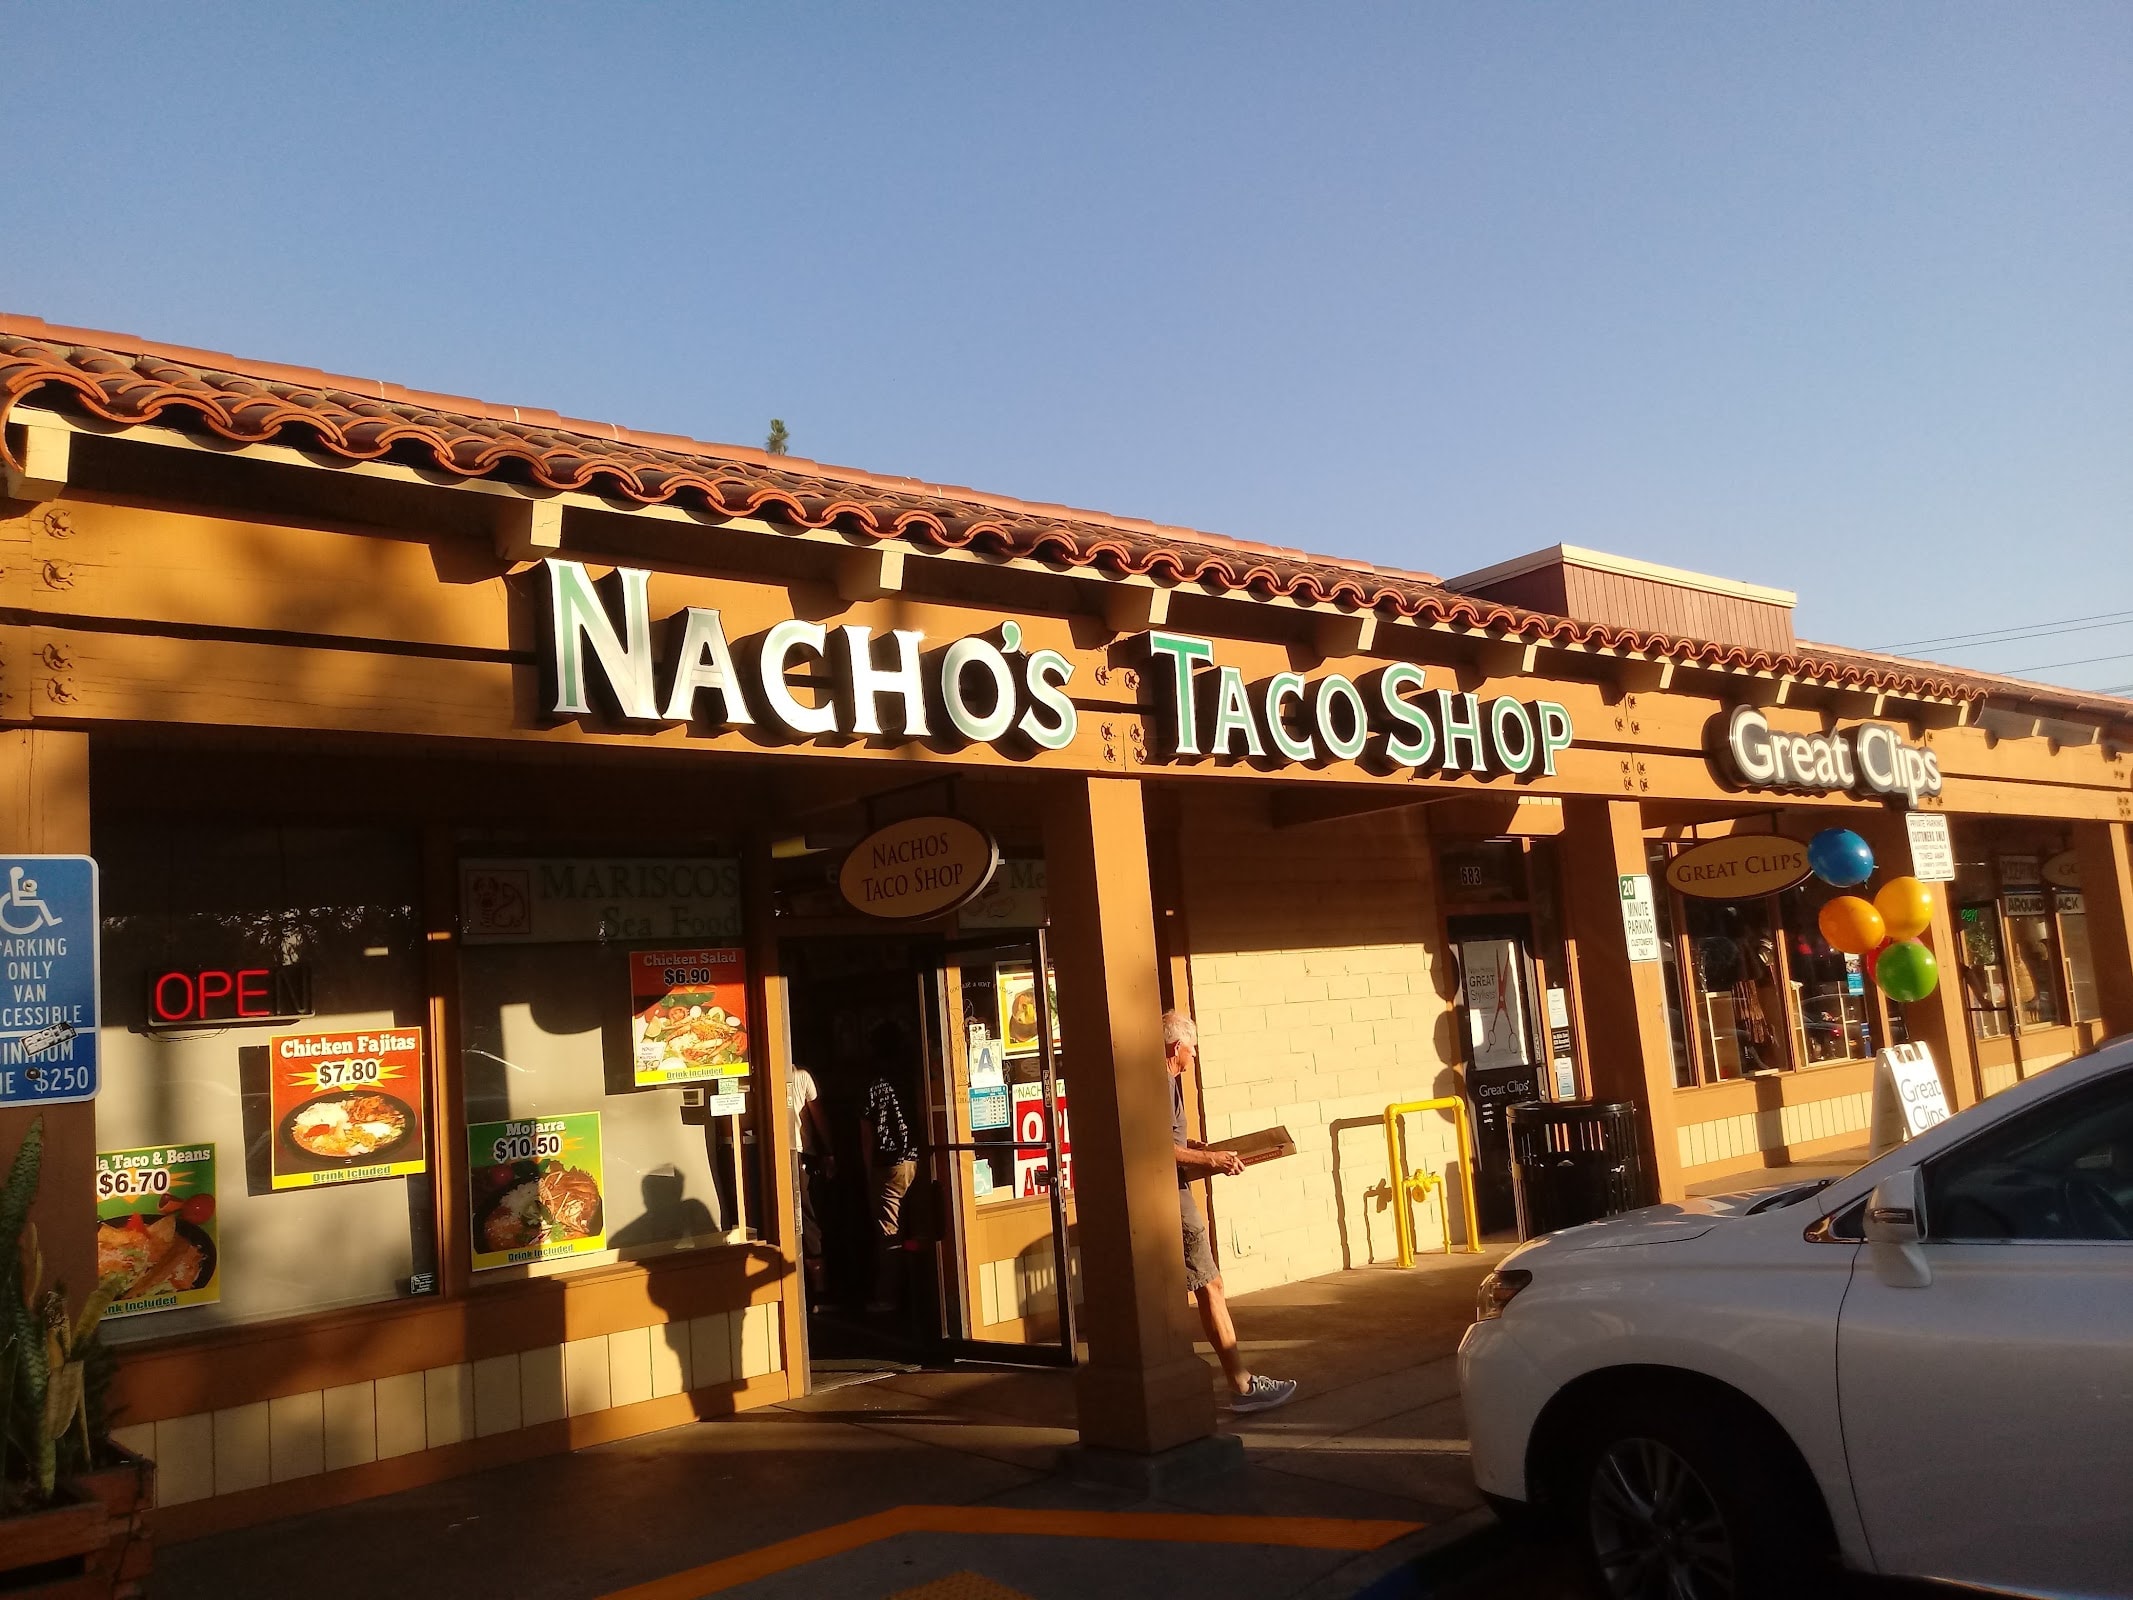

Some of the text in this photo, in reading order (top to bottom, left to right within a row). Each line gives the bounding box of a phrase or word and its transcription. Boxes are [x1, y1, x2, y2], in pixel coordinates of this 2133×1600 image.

[543, 557, 1078, 751] NACHO'S
[1149, 629, 1574, 776] TACO SHOP
[1733, 710, 1942, 810] Great Clips
[872, 832, 948, 869] NACHOS
[1460, 867, 1481, 885] 683
[1676, 853, 1803, 883] GREAT CLIPS
[539, 864, 738, 900] MARISCOS
[862, 874, 908, 902] TACO
[914, 863, 963, 893] SHOP
[1622, 880, 1634, 896] 20
[1627, 901, 1649, 917] MINUTE
[2056, 896, 2079, 911] ACK
[600, 904, 739, 938] Sea Food
[1628, 919, 1653, 935] PARKING
[1631, 937, 1654, 947] CUSTOMERS
[1638, 948, 1648, 956] ONLY
[643, 951, 737, 967] Chicken Salad
[8, 961, 53, 981] ONLY
[663, 968, 711, 986] $6.90
[1469, 974, 1495, 988] GREAT
[14, 984, 46, 1003] VAN
[154, 968, 311, 1020] OPEN
[2, 1005, 82, 1028] CESSIBLE
[280, 1033, 416, 1059] Chicken Fajitas
[978, 1048, 996, 1073] A
[34, 1065, 89, 1094] $250
[319, 1060, 378, 1086] $7.80
[666, 1067, 724, 1080] Drink Included
[1478, 1078, 1529, 1097] Great Clips
[1900, 1078, 1947, 1130] Great Clips
[505, 1120, 567, 1137] Mojarra
[112, 1153, 150, 1170] Taco
[152, 1151, 164, 1166] &
[166, 1148, 211, 1164] Beans
[495, 1136, 560, 1161] $10.50
[98, 1170, 168, 1196] $6.70
[312, 1170, 344, 1183] Drink
[508, 1244, 575, 1263] Drink Included
[125, 1295, 177, 1311] Included
